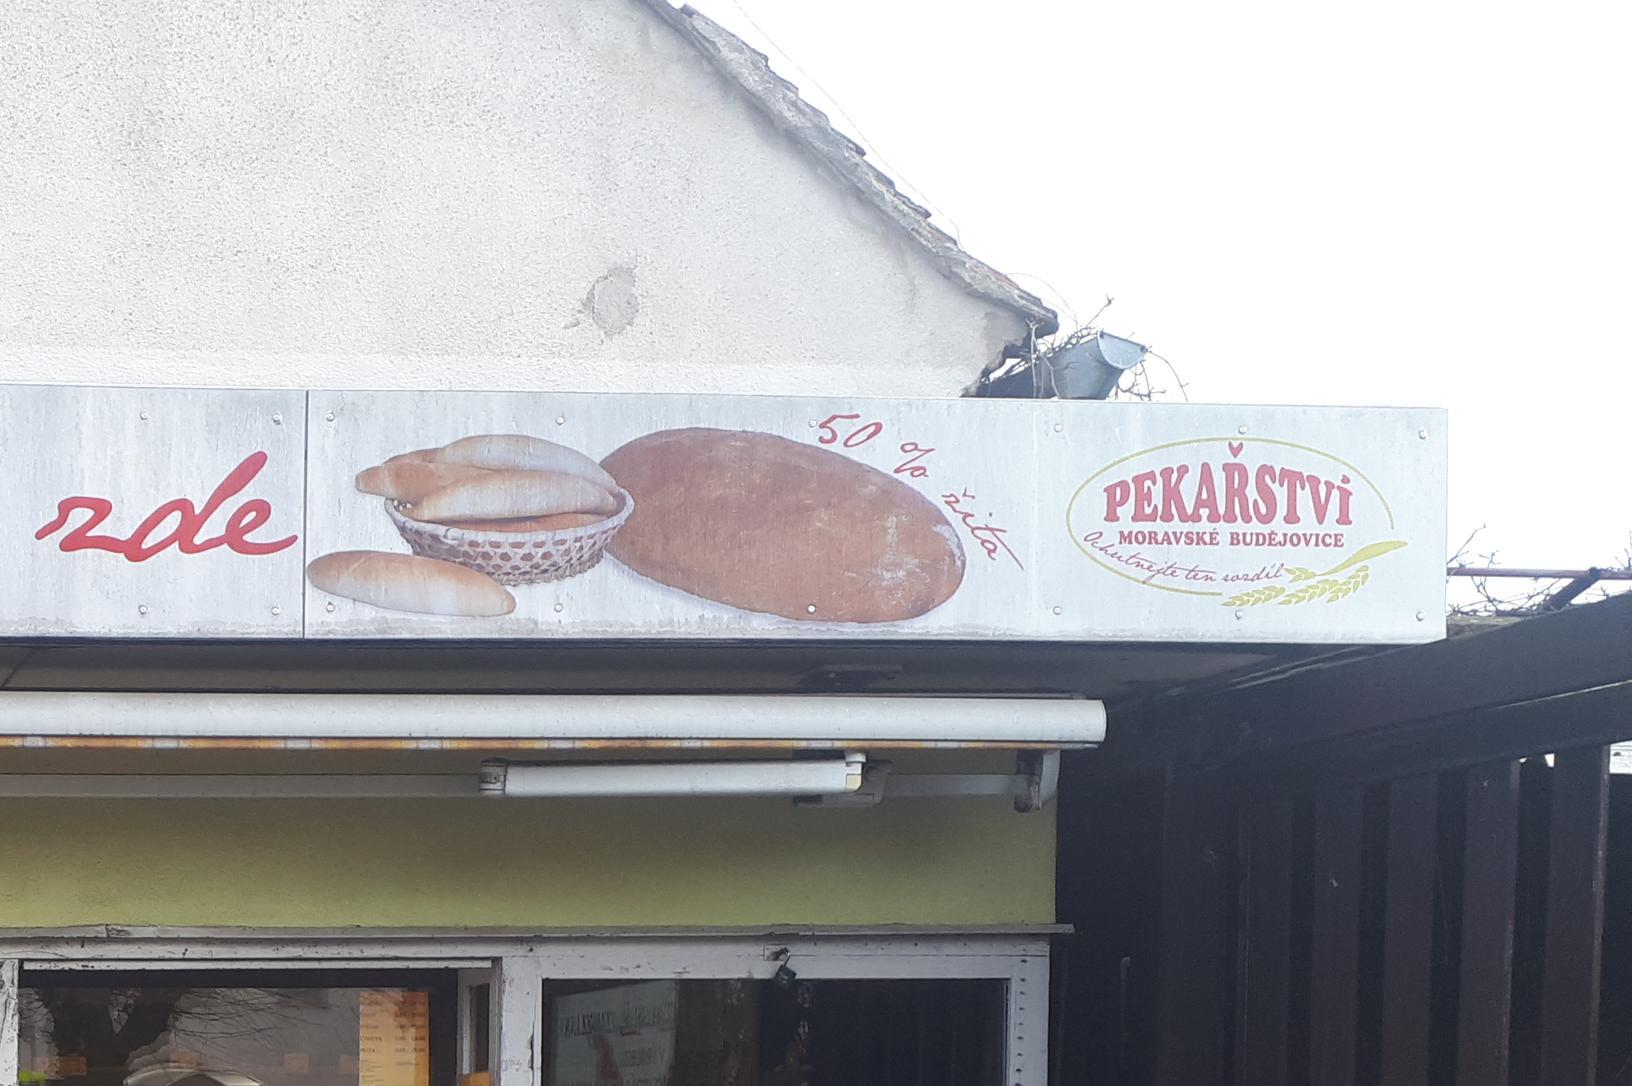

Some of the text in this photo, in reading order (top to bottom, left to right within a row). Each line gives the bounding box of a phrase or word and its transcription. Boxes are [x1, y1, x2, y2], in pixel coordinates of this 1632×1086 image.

[34, 450, 299, 564] zde
[818, 414, 884, 448] 50
[941, 487, 1024, 571] žita
[1083, 530, 1286, 585] Ochutnejte ten rozdíl
[1118, 528, 1345, 549] MORAVSKÉ BUDĚJOVICE
